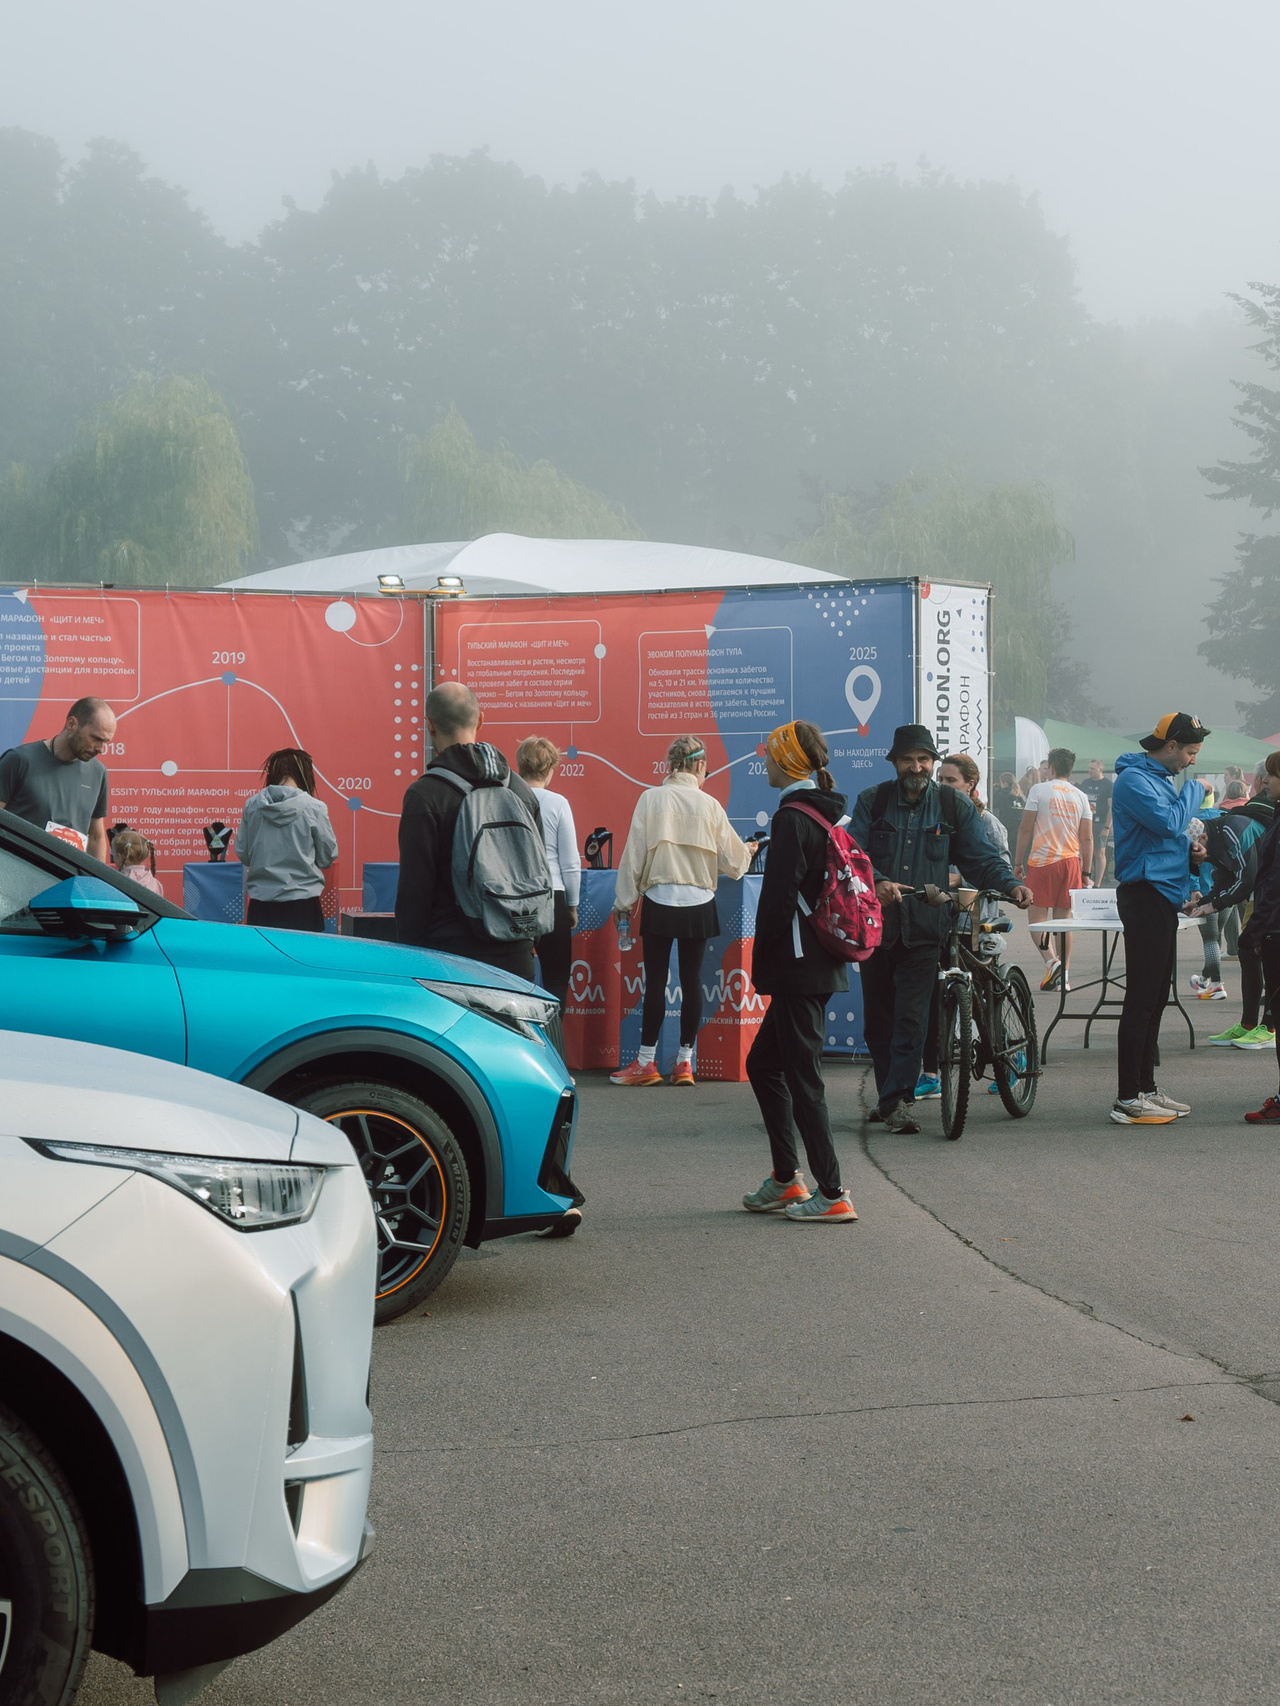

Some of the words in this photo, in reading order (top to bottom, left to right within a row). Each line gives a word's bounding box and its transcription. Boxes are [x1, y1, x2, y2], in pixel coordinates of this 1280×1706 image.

[0, 614, 45, 623] МАРАФОН
[49, 616, 72, 624] «ЩИТ
[83, 616, 104, 624] МЕЧ»
[5, 633, 48, 641] название
[58, 634, 78, 642] стал
[4, 645, 40, 653] проекта
[467, 640, 497, 650] ТУЛЬСКИЙ
[498, 641, 528, 649] МАРАФОН
[211, 651, 246, 664] 2019
[647, 650, 674, 659] ЭВОКОМ
[675, 649, 725, 658] ПОЛУМАРАФОН
[726, 648, 743, 656] ТУЛА
[849, 646, 878, 660] 2025
[1, 654, 28, 662] Бегом
[43, 655, 85, 664] Золотому
[87, 656, 124, 665] кольцу».
[467, 659, 526, 667] Восстанавливаемся
[556, 657, 586, 666] несмотря
[25, 665, 72, 674] дистанции
[93, 667, 135, 675] взрослых
[476, 669, 511, 677] глобальные
[551, 667, 585, 676] Последний
[648, 667, 681, 677] Обновили
[683, 668, 705, 677] трассы
[706, 667, 739, 675] основных
[740, 665, 767, 674] забегов
[4, 675, 30, 684] детей
[506, 679, 522, 687] забег
[554, 679, 573, 687] серии
[665, 679, 672, 687] 10
[679, 679, 686, 687] 21
[699, 678, 734, 687] Увеличили
[735, 677, 774, 685] количество
[505, 690, 523, 698] Бегом
[534, 690, 562, 698] Золотому
[707, 688, 743, 697] двигаемся
[750, 688, 776, 696] лучшим
[648, 701, 689, 709] показателям
[695, 700, 723, 708] истории
[750, 698, 785, 707] Встречаем
[647, 711, 669, 720] гостей
[684, 712, 703, 720] стран
[710, 710, 718, 718] 36
[719, 710, 752, 719] регионов
[753, 709, 778, 718] России.
[101, 742, 125, 756] 018
[834, 748, 845, 757] ВЫ
[652, 761, 670, 774] 202
[748, 762, 768, 775] 202
[851, 759, 874, 769] ЗДЕСЬ
[559, 763, 585, 777] 2022
[337, 777, 372, 790] 2020
[110, 787, 138, 796] ESSITY
[140, 786, 185, 796] ТУЛЬСКИЙ
[187, 788, 229, 797] МАРАФОН
[119, 805, 139, 814] 2019
[143, 807, 162, 815] году
[164, 806, 204, 815] марафон
[227, 807, 243, 815] одн
[139, 816, 192, 825] спортивных
[193, 816, 231, 824] событий
[138, 827, 175, 836] получил
[177, 828, 204, 836] серти
[159, 837, 190, 846] собрал
[171, 848, 192, 856] 2000
[510, 925, 539, 933] adidas
[576, 1007, 606, 1015] МАРАФОН
[623, 1007, 643, 1016] ТУЛЬС
[664, 1009, 682, 1017] РАФО
[702, 1016, 733, 1025] ТУЛЬСКИЙ
[451, 1162, 465, 1241] MICHELIN
[0, 1460, 73, 1622] ESPORT
